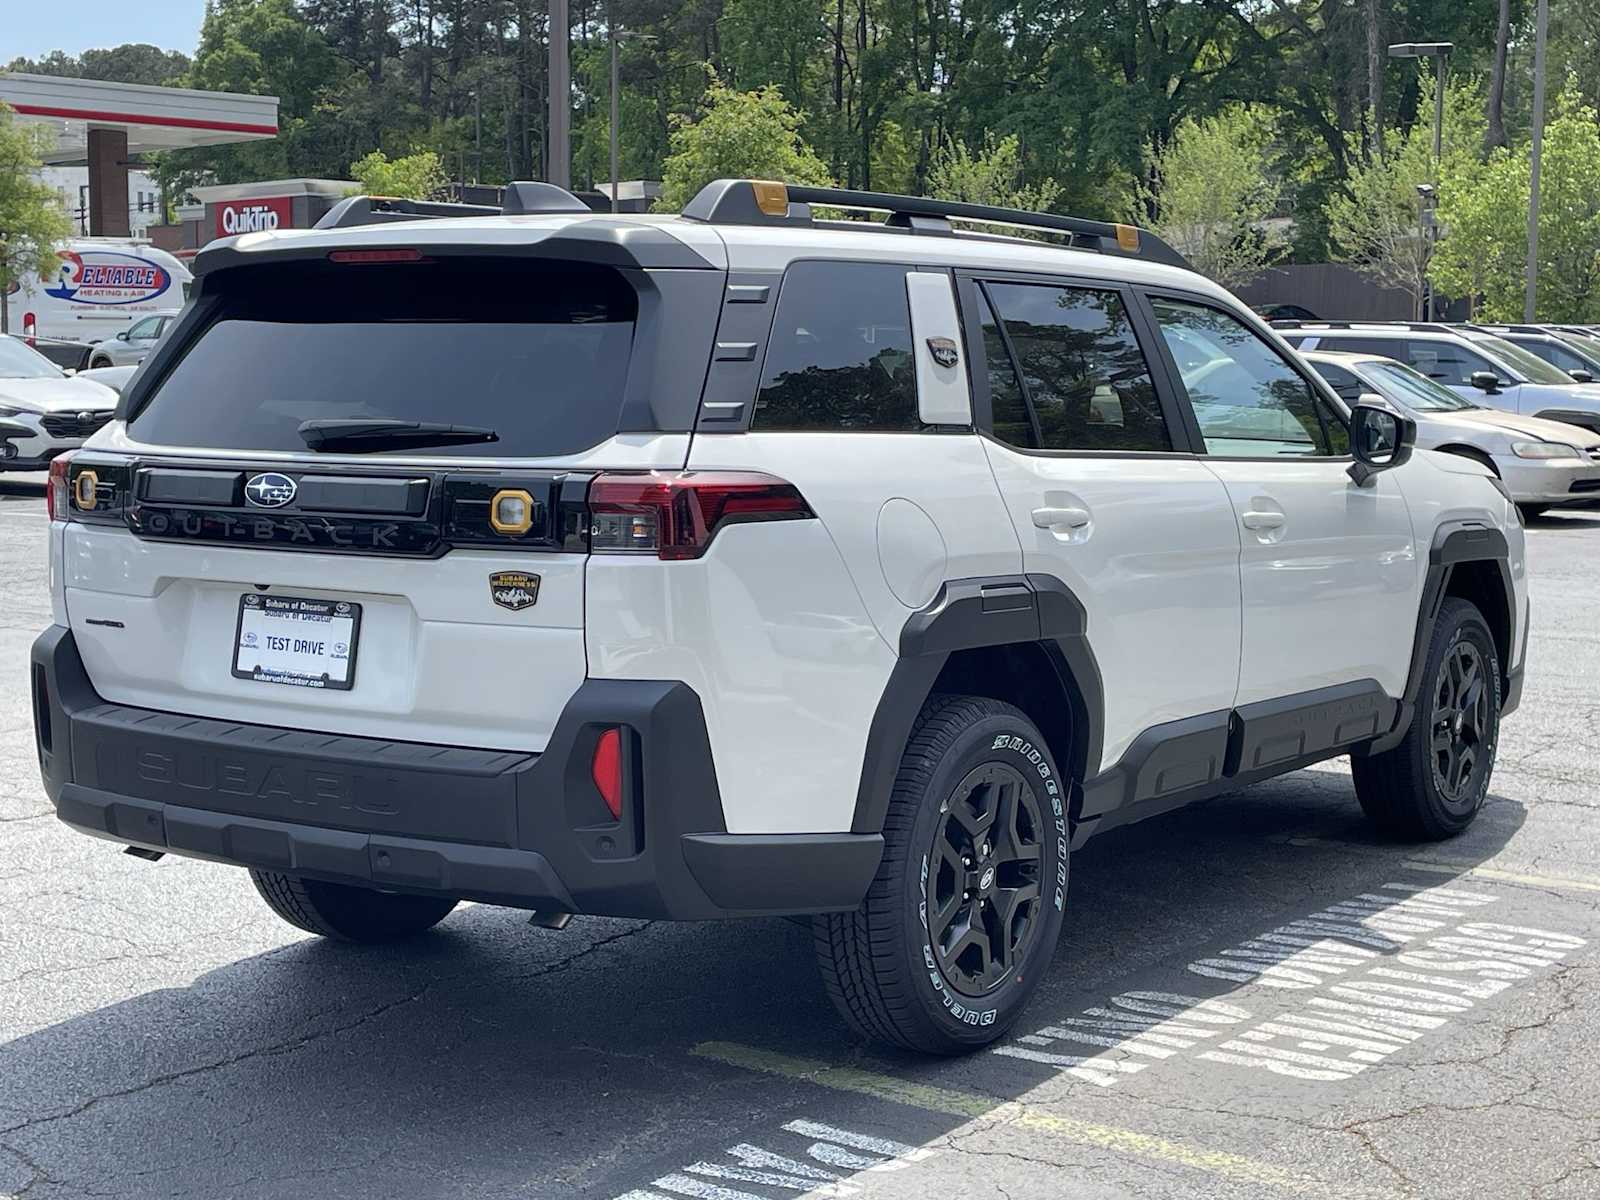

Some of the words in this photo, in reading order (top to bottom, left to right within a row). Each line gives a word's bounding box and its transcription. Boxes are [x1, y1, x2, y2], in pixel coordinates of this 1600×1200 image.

[222, 205, 278, 234] QuikTrip
[45, 250, 157, 290] RELIABLE
[148, 514, 399, 546] OUTBACK
[265, 598, 290, 610] Subaru
[291, 600, 299, 610] of
[300, 602, 329, 612] Decatur
[266, 636, 291, 652] TEST
[293, 639, 325, 656] DRIVE
[254, 674, 325, 688] subaruofdecatur.com
[137, 751, 401, 816] SUBARU
[991, 734, 1072, 914] BRIDGESTONE
[1187, 881, 1499, 990] PARKING
[922, 943, 998, 1028] DUELER
[1195, 922, 1587, 1081] CUSTOMER
[990, 989, 1253, 1087] ONLY
